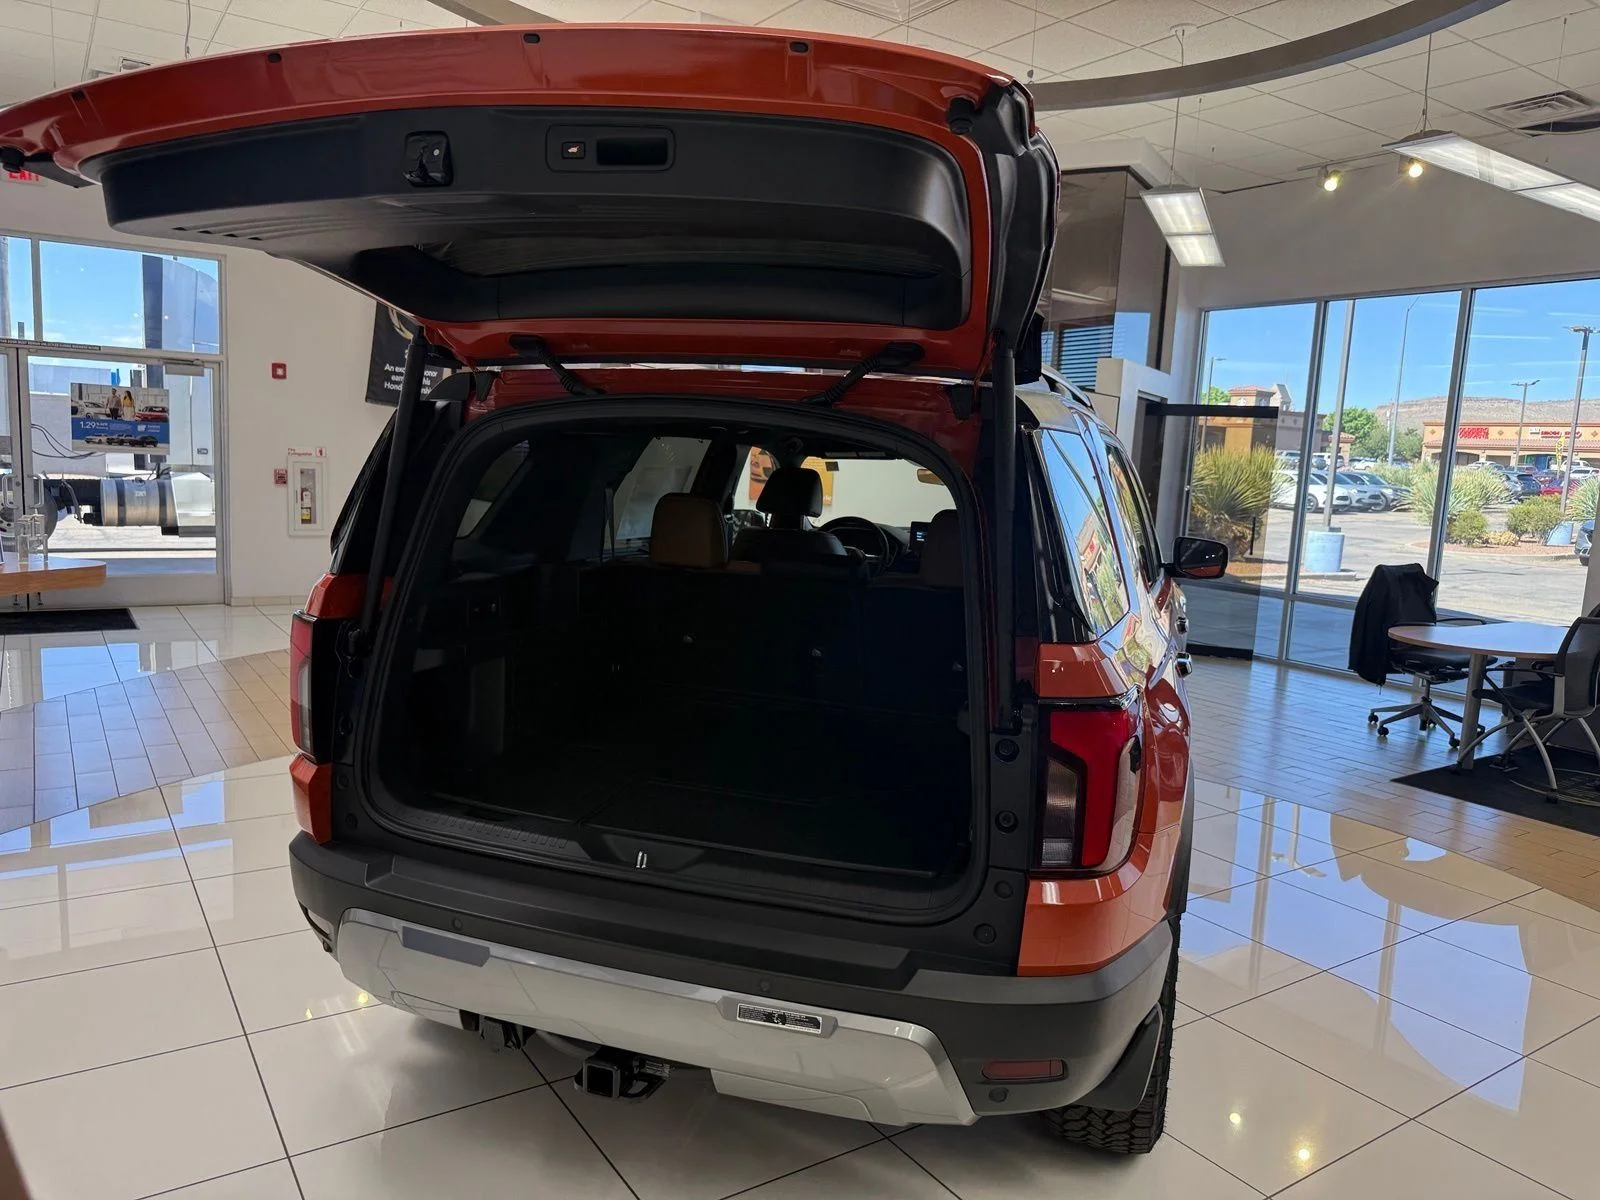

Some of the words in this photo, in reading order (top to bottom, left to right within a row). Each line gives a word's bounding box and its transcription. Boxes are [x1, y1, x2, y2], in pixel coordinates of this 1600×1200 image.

[384, 363, 394, 372] An
[384, 381, 403, 391] Hond
[79, 421, 96, 429] 1.29
